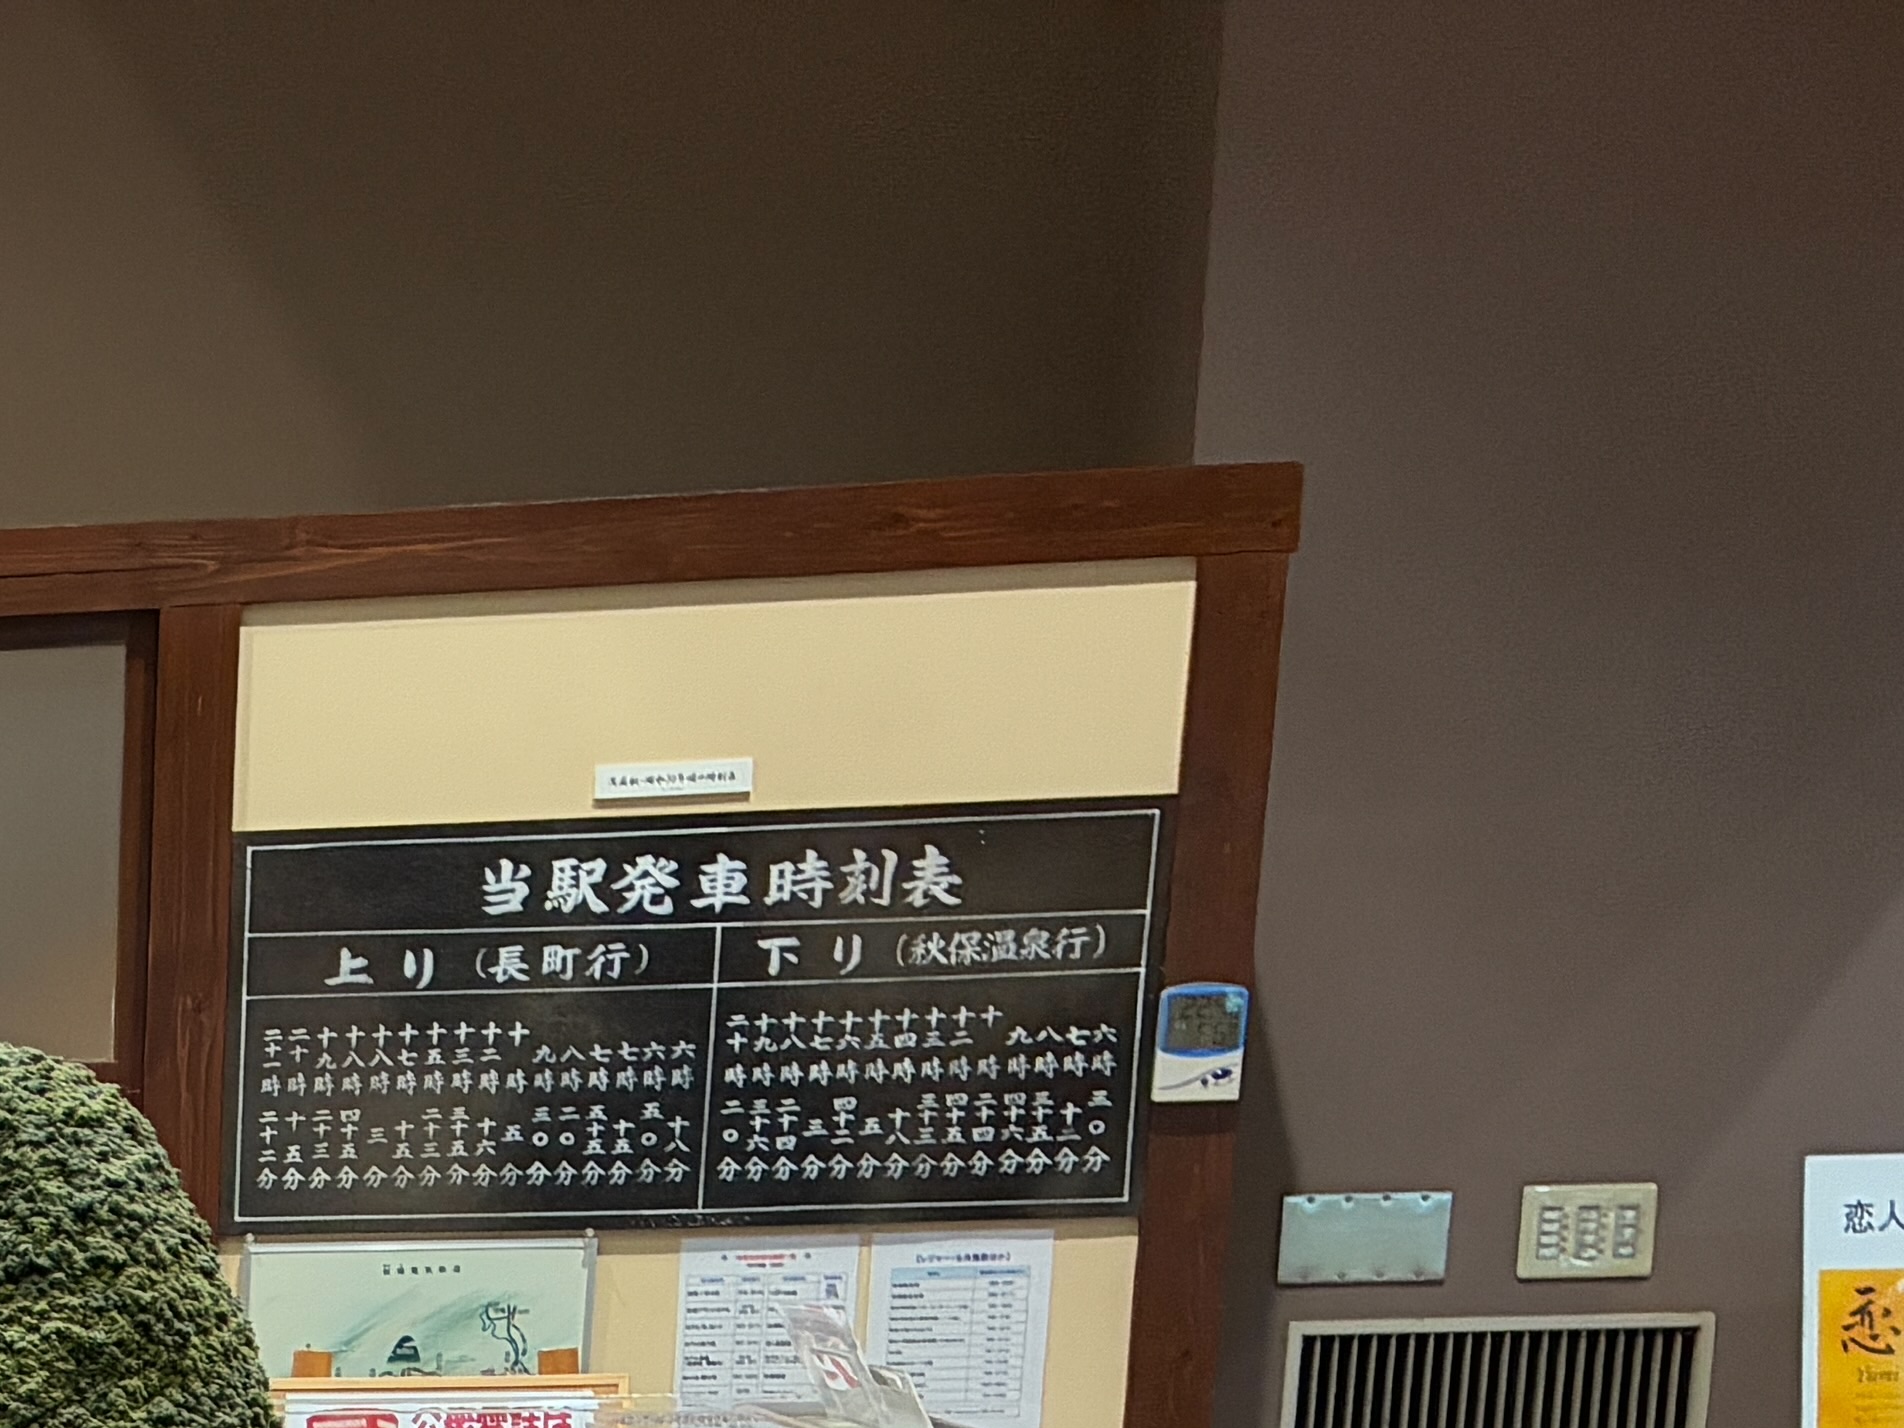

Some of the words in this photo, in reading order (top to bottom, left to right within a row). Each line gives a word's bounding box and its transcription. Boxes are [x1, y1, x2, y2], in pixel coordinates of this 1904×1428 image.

[481, 845, 964, 918] 当駅発車時刻表
[1843, 1199, 1904, 1234] 恋人
